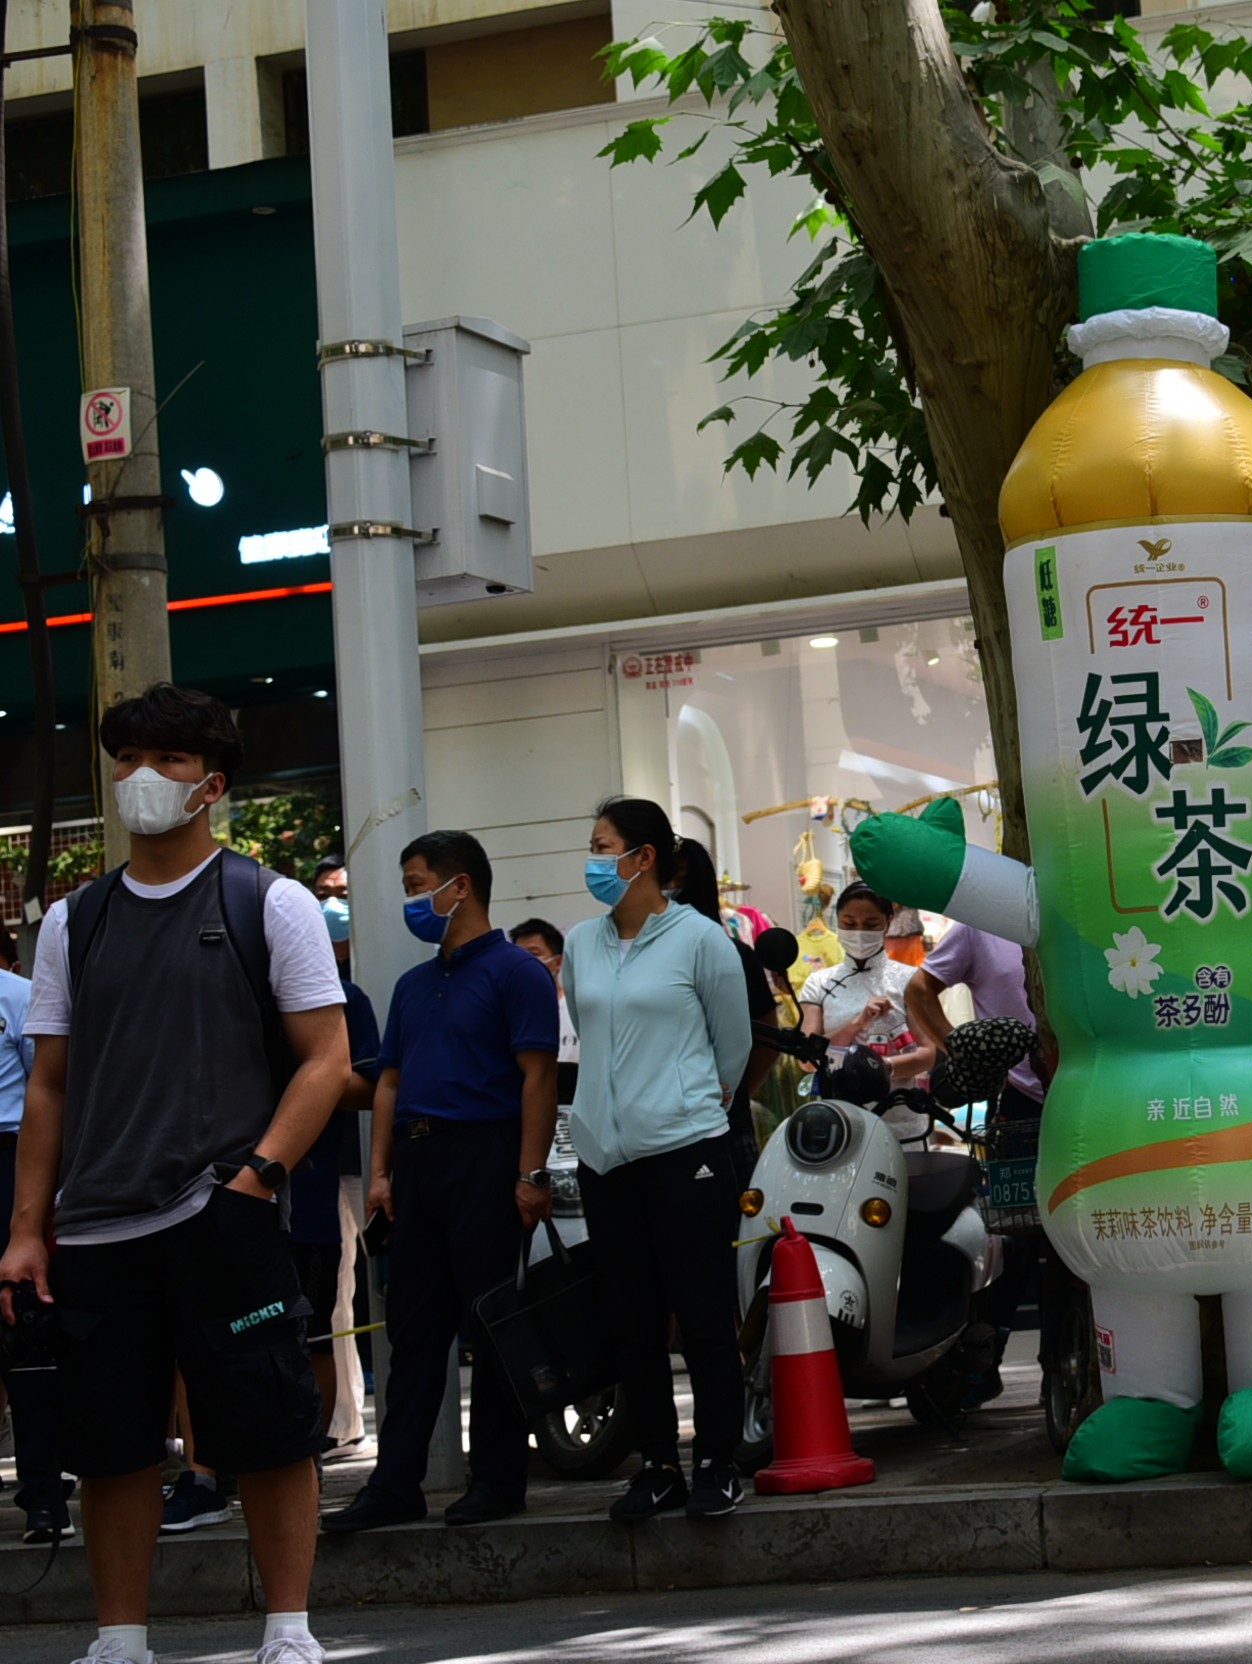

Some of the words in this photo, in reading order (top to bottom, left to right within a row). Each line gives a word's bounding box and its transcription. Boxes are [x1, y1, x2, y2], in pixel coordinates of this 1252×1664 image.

[1107, 604, 1204, 648] 统一
[1196, 966, 1231, 989] 含有
[1153, 992, 1230, 1028] 茶多酚
[1146, 1093, 1240, 1121] 亲近自然
[1090, 1205, 1194, 1241] 茉莉味茶饮料
[229, 1300, 286, 1335] MICKEY
